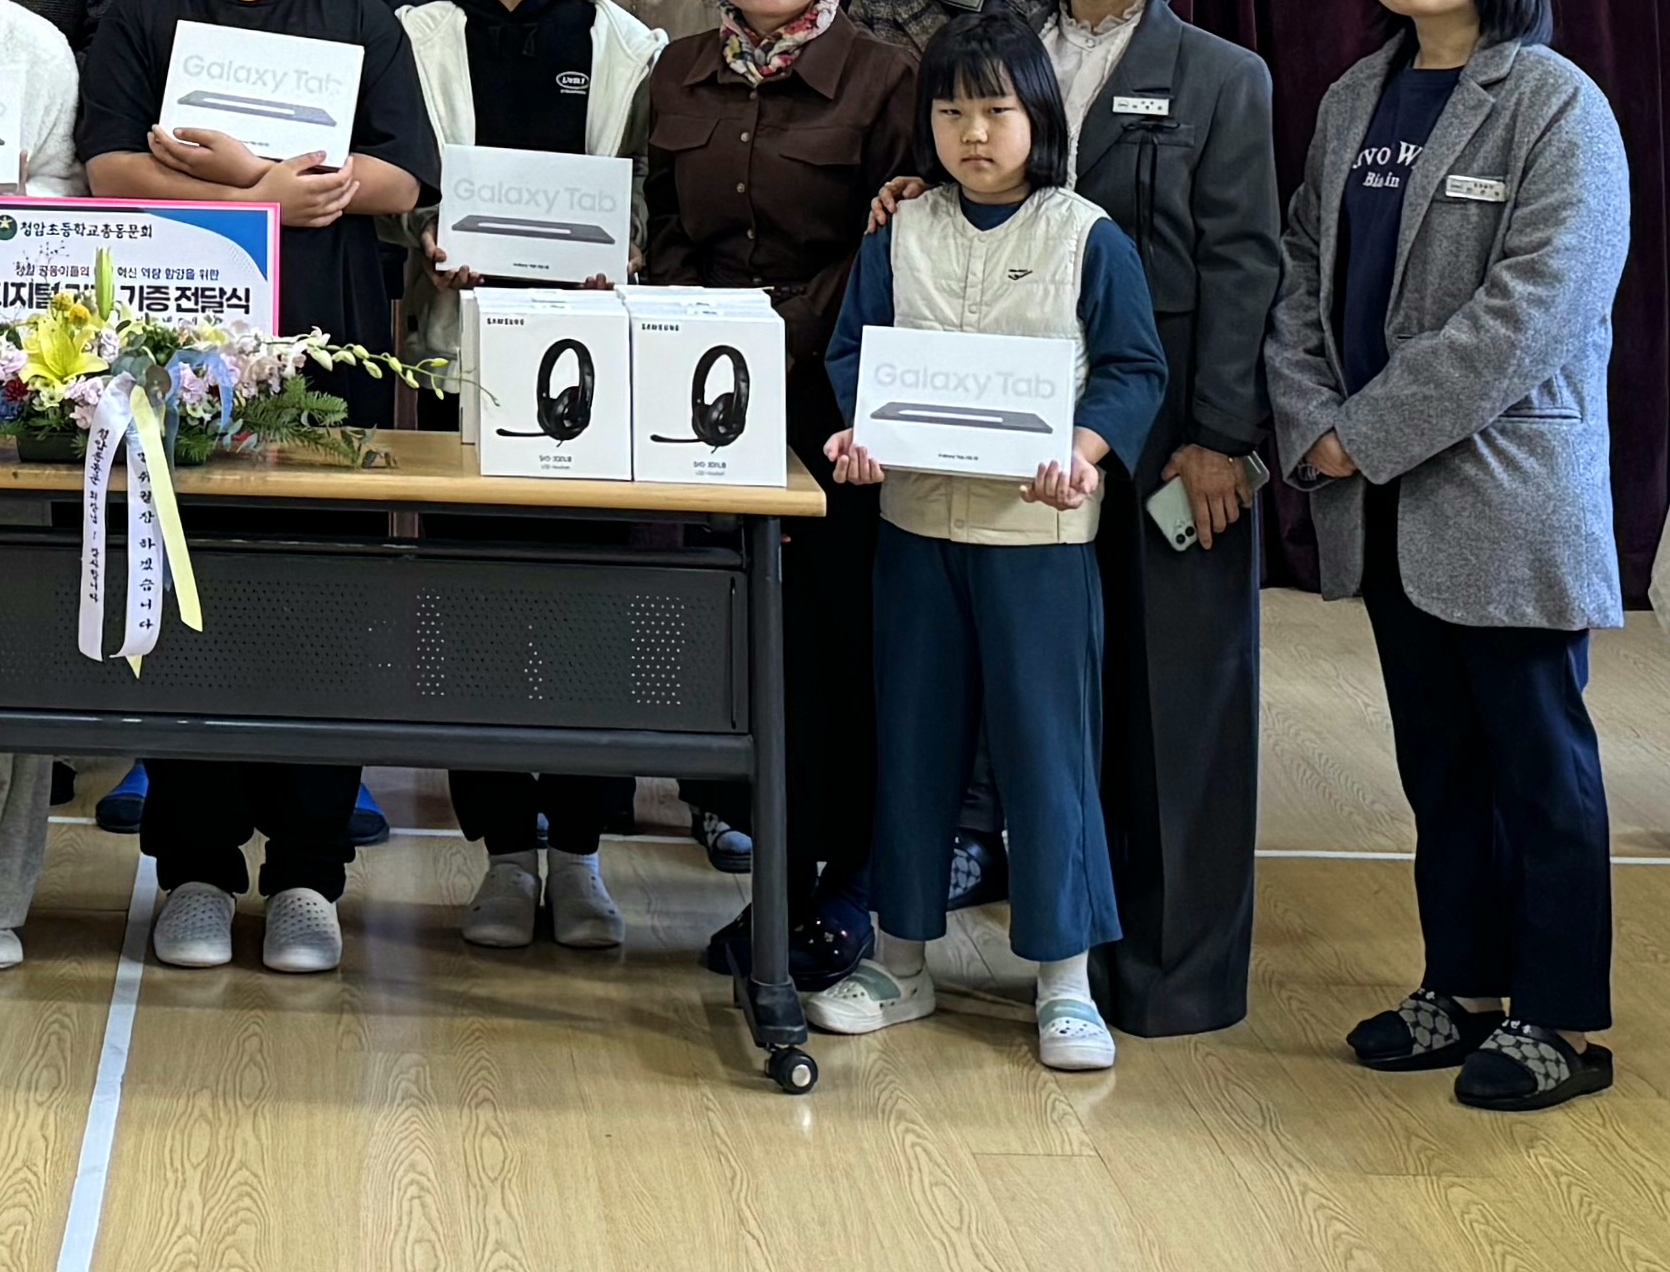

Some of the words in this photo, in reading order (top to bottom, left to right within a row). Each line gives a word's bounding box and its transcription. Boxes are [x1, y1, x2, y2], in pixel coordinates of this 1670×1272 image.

[183, 55, 288, 93] Galaxy
[453, 177, 561, 215] Galaxy
[563, 187, 617, 214] Tab
[119, 285, 171, 313] 기증
[174, 285, 251, 314] 전달식
[873, 362, 991, 400] Galaxy
[995, 371, 1057, 399] Tab
[138, 537, 156, 630] 하겠습니다
